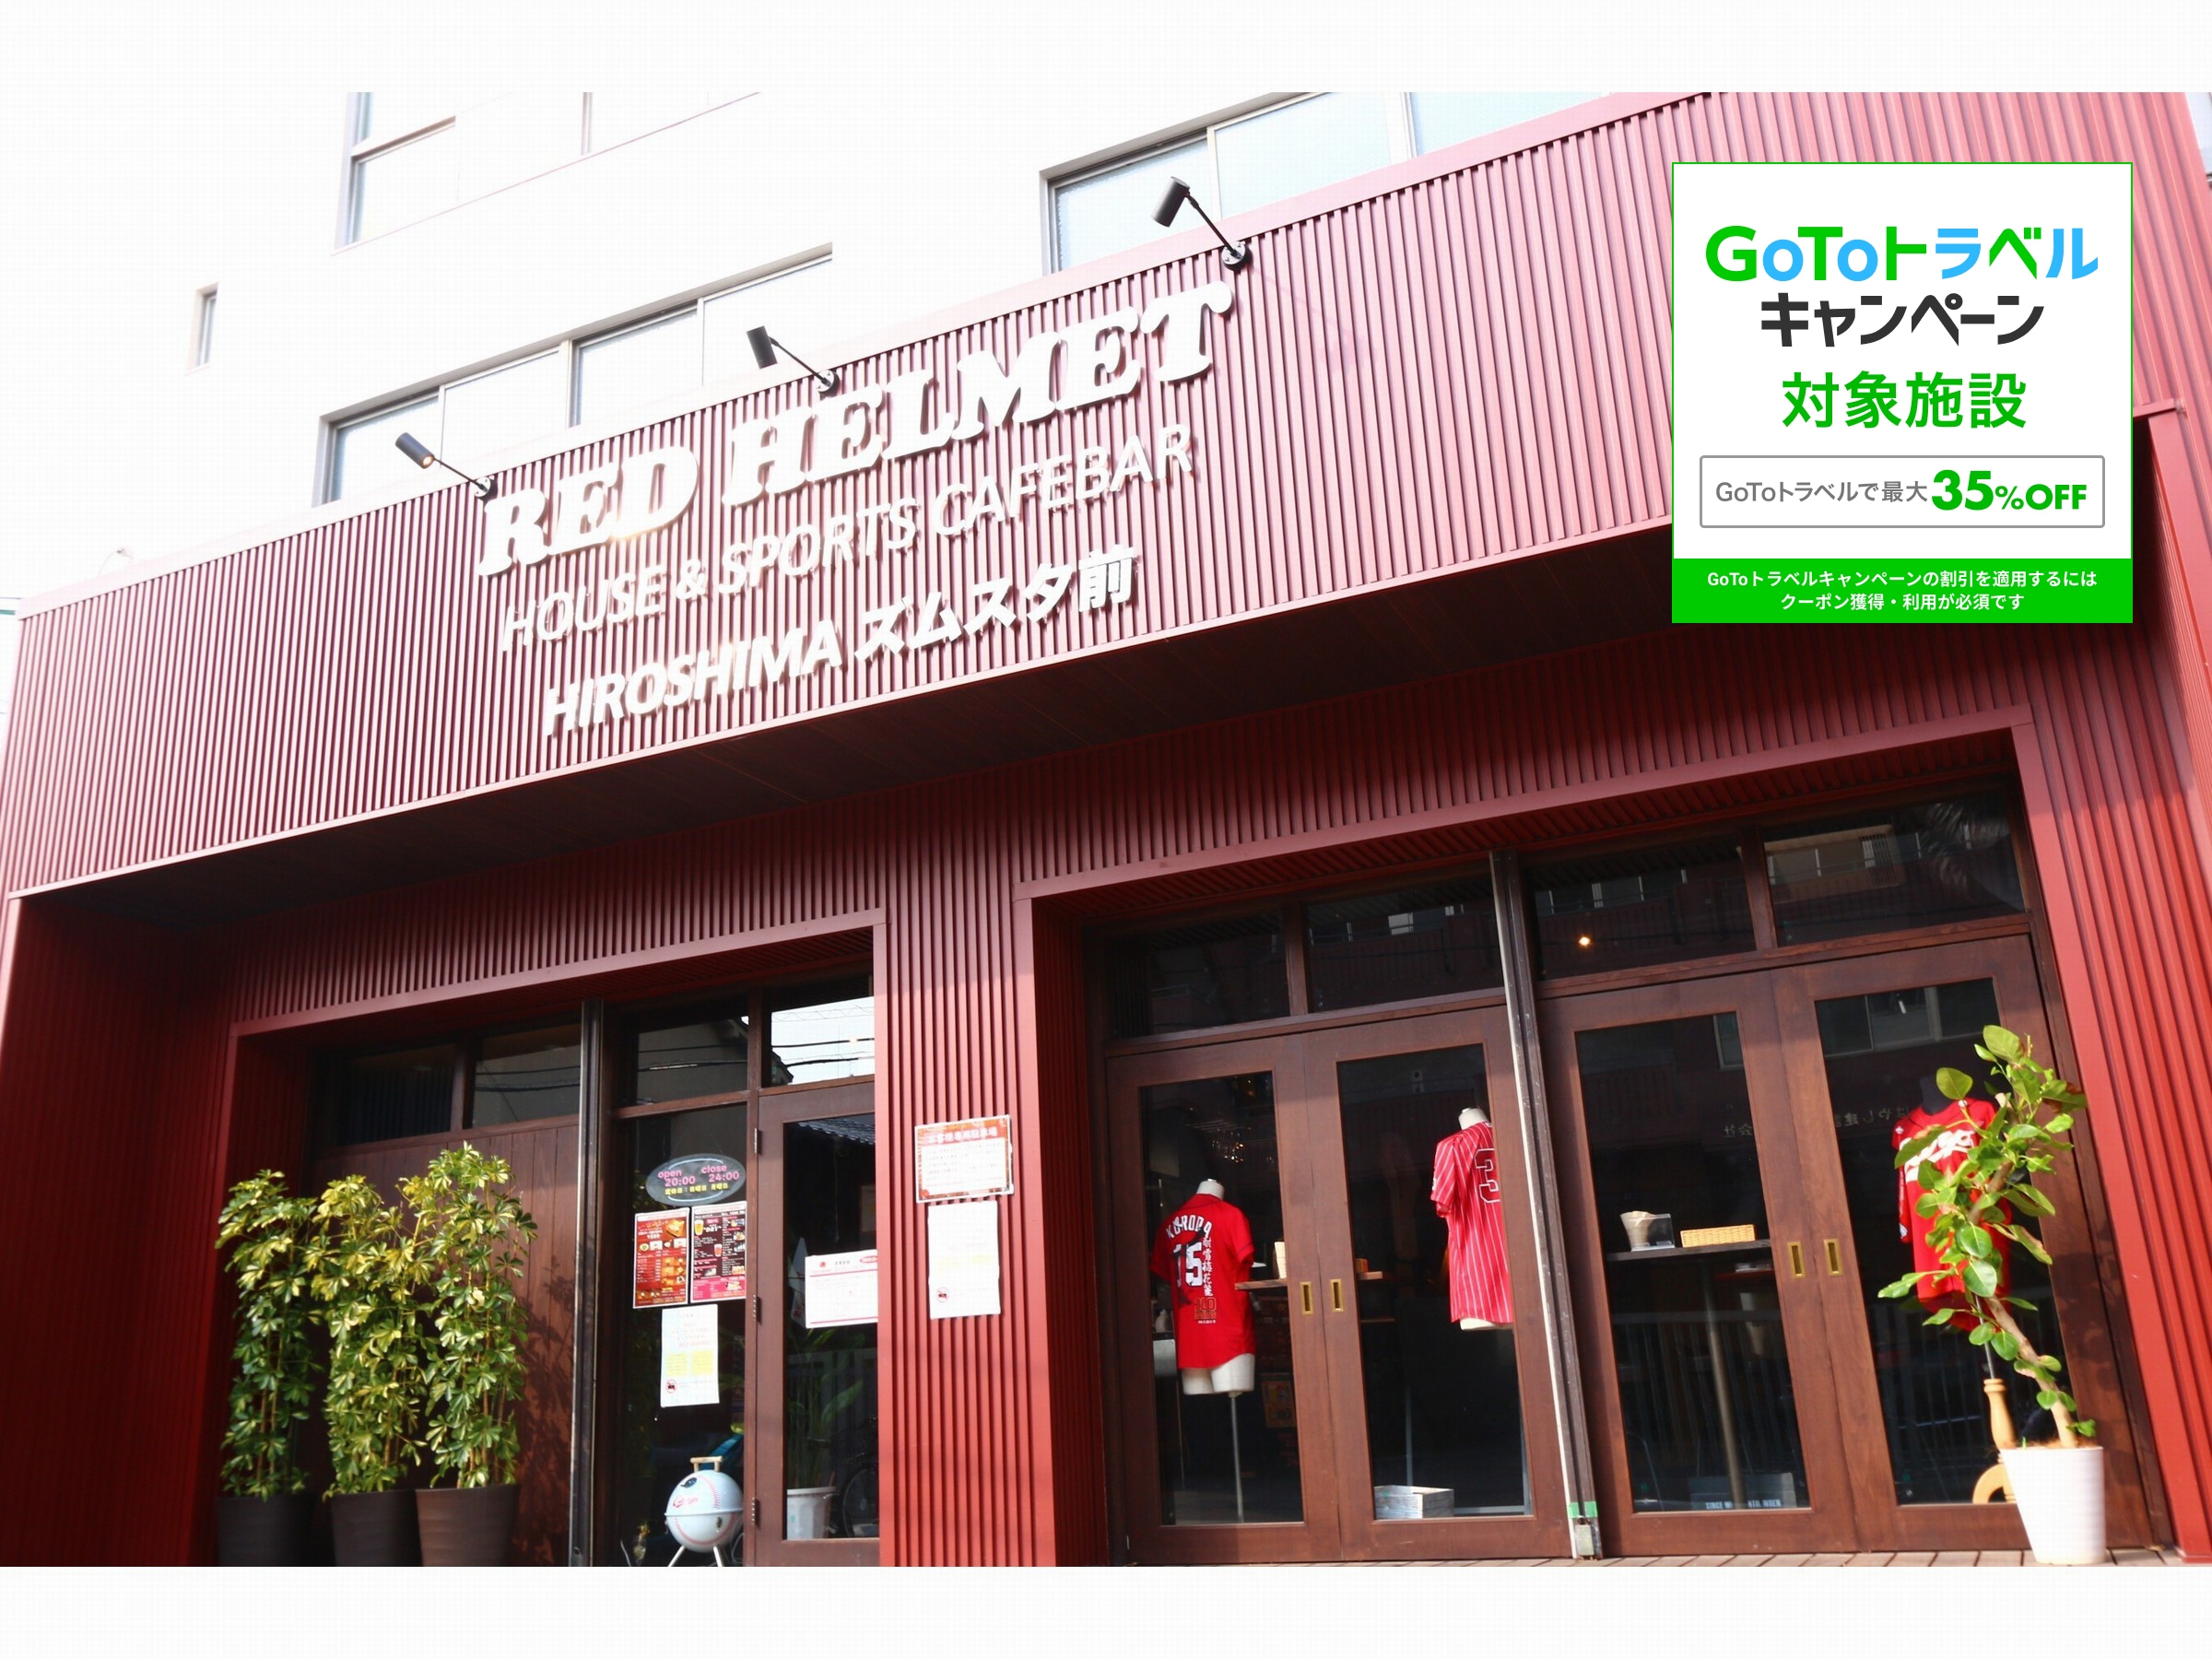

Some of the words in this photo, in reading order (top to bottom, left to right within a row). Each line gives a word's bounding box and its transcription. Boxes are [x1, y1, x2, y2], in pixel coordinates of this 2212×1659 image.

[478, 446, 700, 576] RED
[723, 281, 1233, 506] HELMET
[502, 558, 667, 652] HOUSE
[675, 554, 710, 603] &
[720, 496, 919, 595] SPORTS
[933, 423, 1193, 536] CAFEBAR
[546, 621, 843, 736] HIROSHIMA
[854, 544, 1136, 661] ズムスタ前
[657, 1170, 682, 1180] open
[701, 1164, 727, 1173] close
[665, 1176, 696, 1187] 20:00
[708, 1171, 740, 1182] 24:00
[1173, 1241, 1204, 1288] 15
